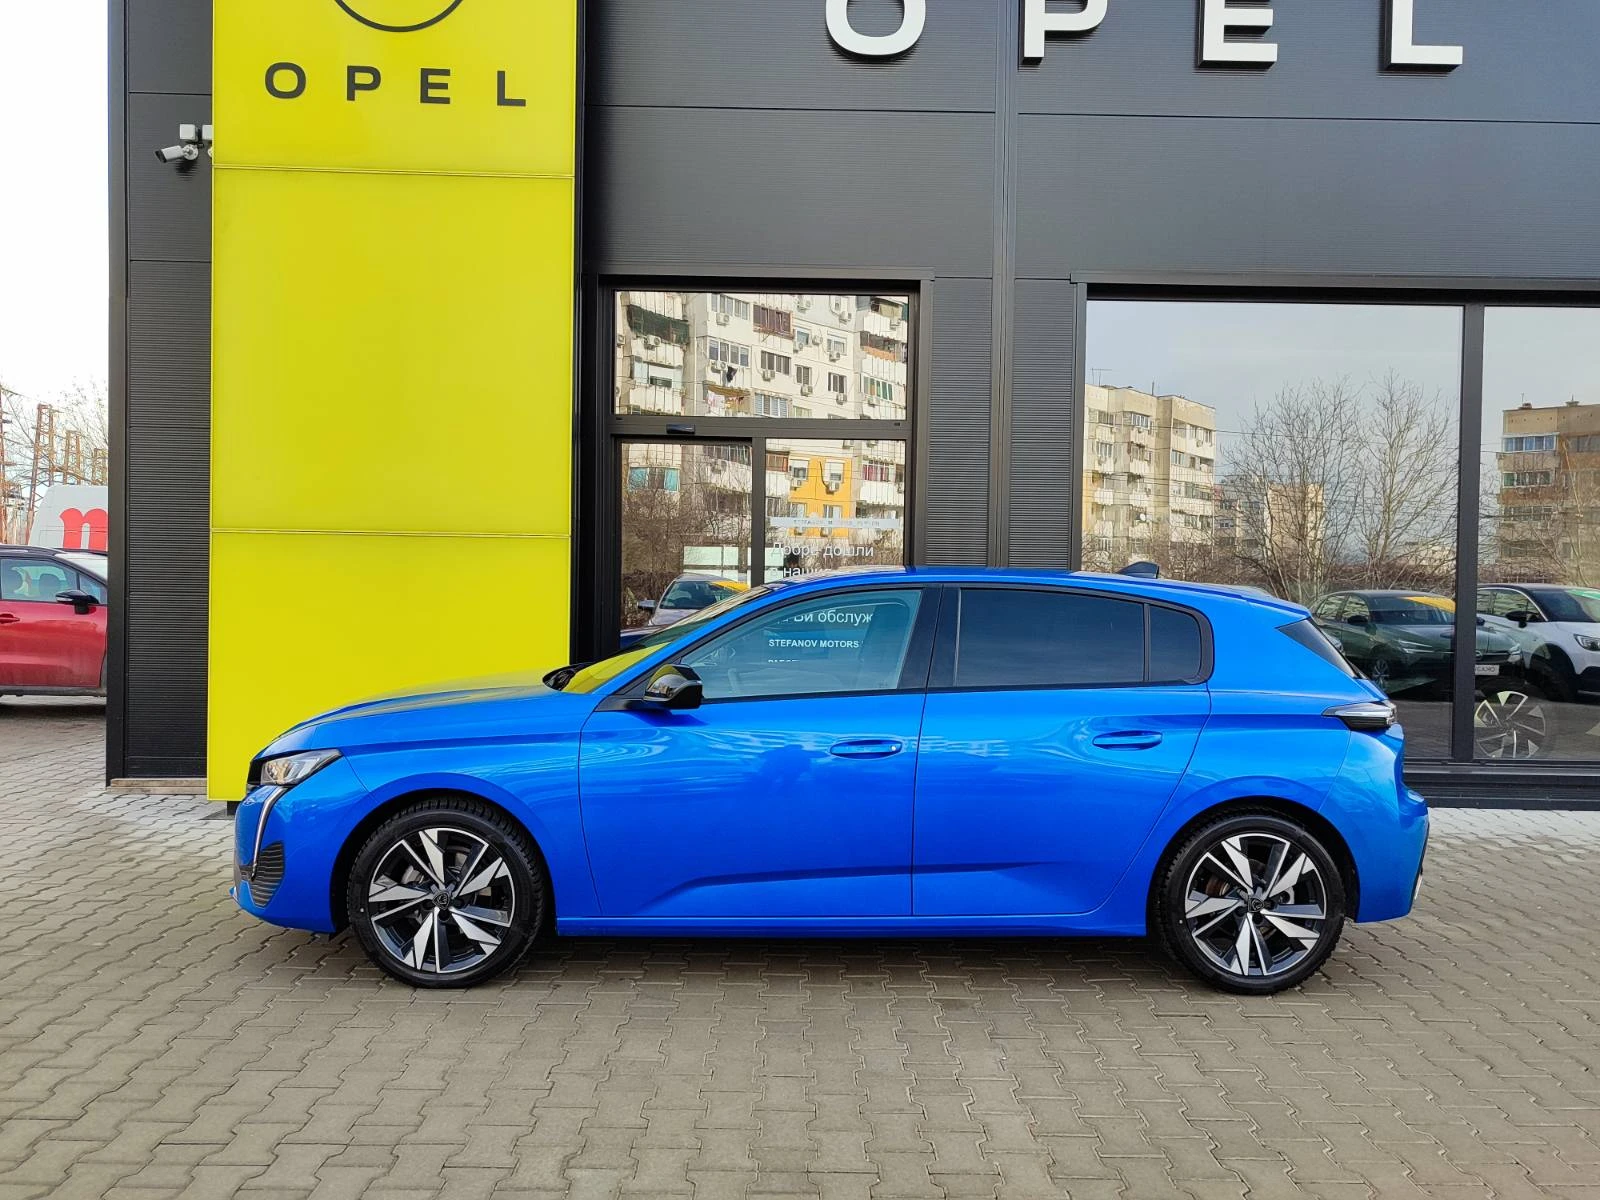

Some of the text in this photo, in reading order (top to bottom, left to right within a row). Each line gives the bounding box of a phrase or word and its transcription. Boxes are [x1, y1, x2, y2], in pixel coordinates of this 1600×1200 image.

[825, 0, 1463, 65] OPEL
[265, 62, 526, 107] OPEL
[823, 545, 874, 559] дошли
[768, 639, 859, 649] STEFANOV MOTORS
